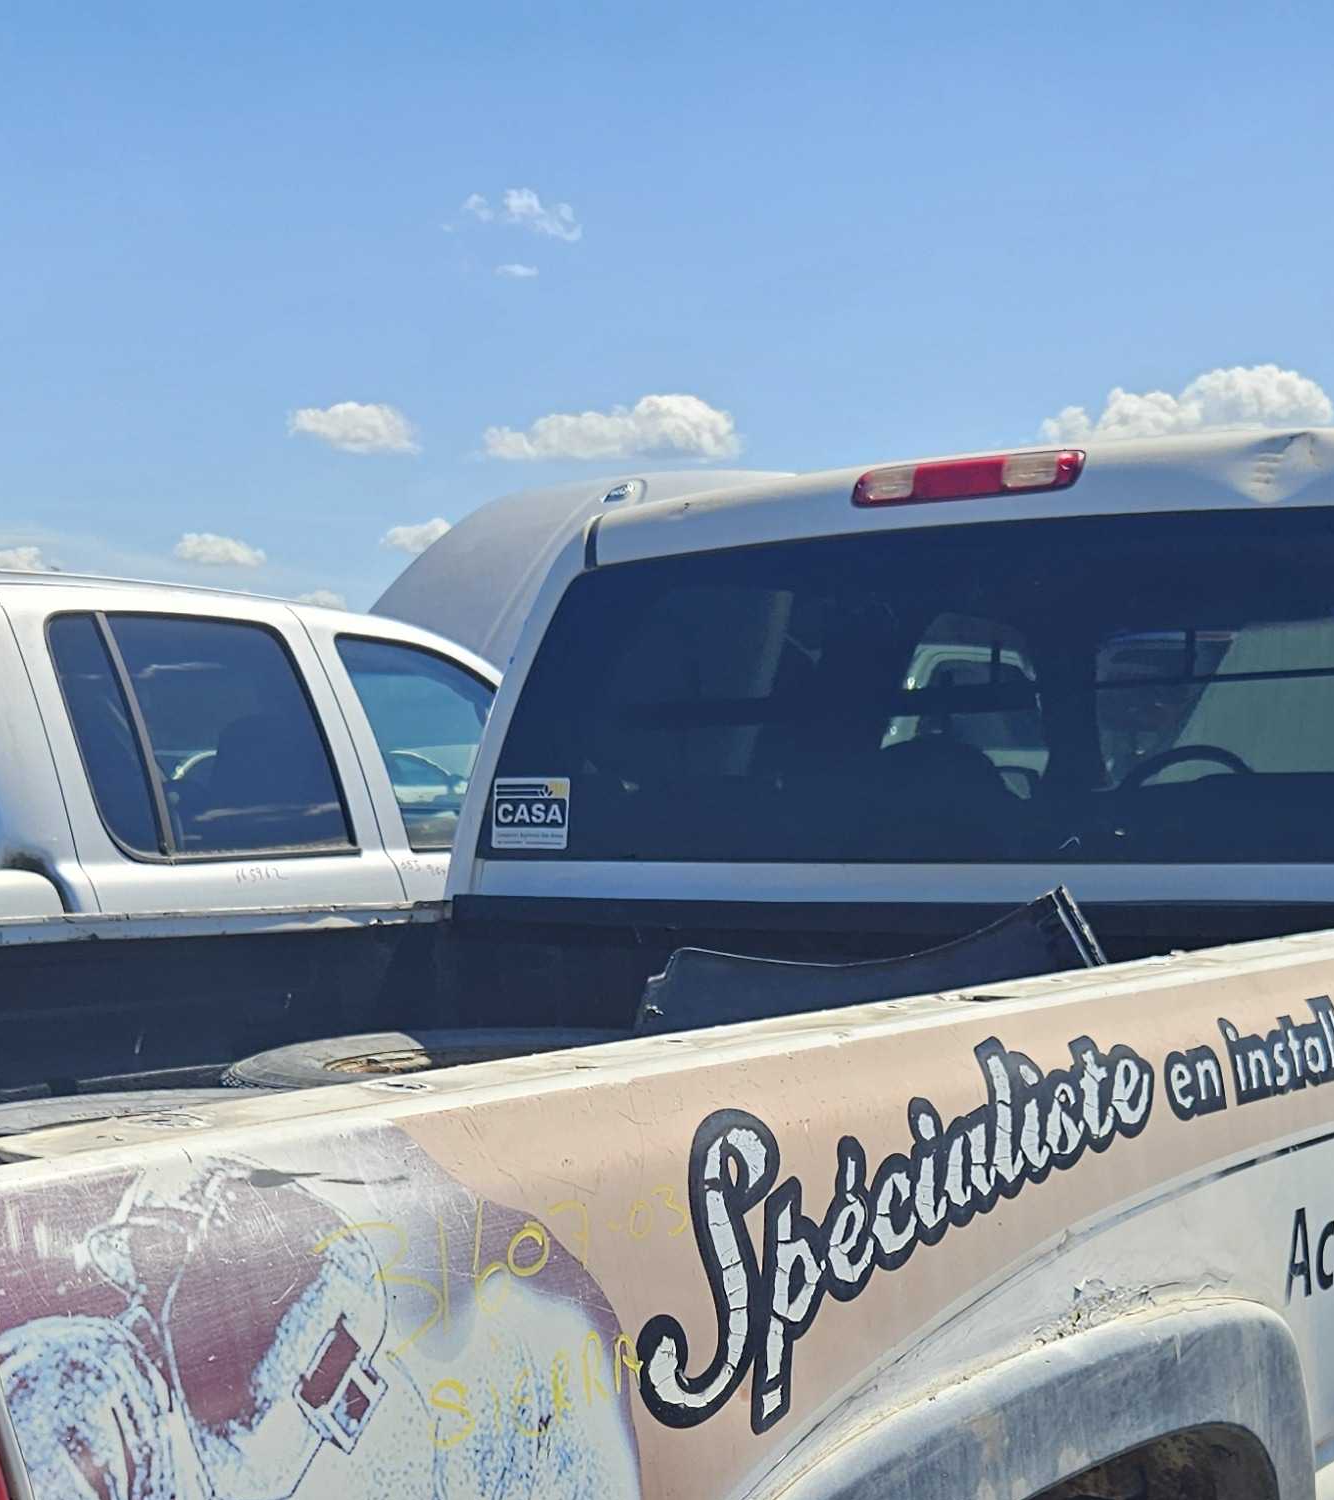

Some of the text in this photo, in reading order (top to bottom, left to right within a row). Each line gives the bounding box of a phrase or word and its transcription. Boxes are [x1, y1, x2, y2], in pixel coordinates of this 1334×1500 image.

[497, 803, 563, 824] CASA
[636, 1036, 1151, 1433] Spécialiste
[1164, 1045, 1227, 1120] en
[429, 1330, 643, 1448] SIERRA
